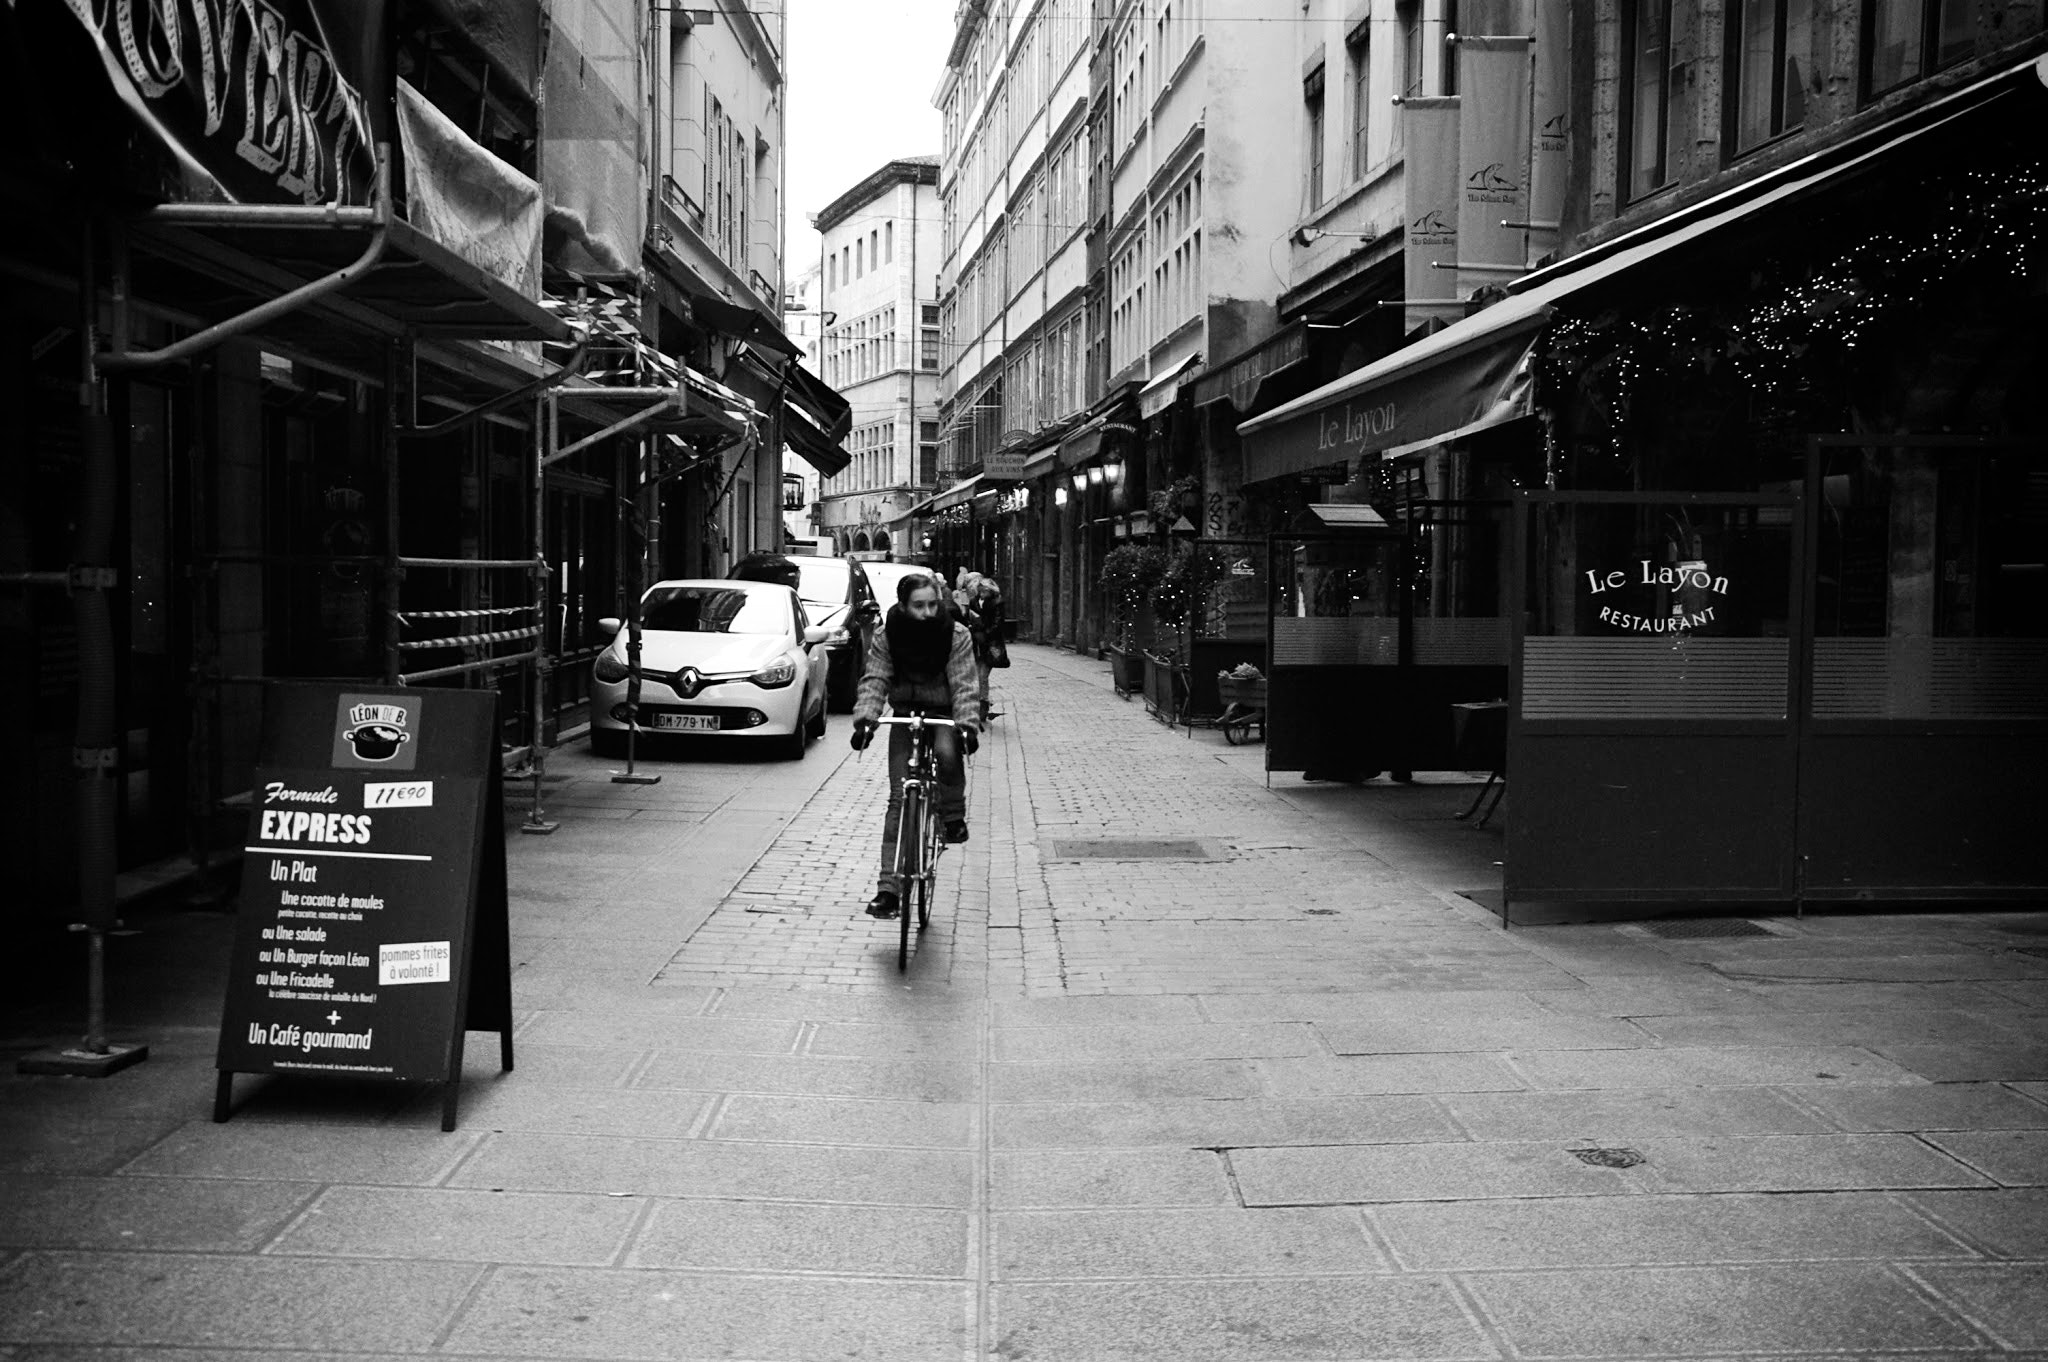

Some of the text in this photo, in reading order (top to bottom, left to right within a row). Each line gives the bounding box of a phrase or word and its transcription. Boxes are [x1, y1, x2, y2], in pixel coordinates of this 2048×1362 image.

[64, 0, 376, 206] UVERT
[1318, 403, 1395, 453] Le Layon
[1585, 560, 1729, 595] Le Layon
[1599, 606, 1716, 633] RESTAURANT
[352, 705, 379, 722] LÉON
[264, 782, 338, 804] Formule
[260, 810, 372, 844] EXPRESS
[270, 860, 317, 882] Un Plat
[281, 890, 384, 909] Une cocotte de moules
[262, 925, 326, 942] ou Une salade
[259, 947, 369, 967] ou Un Burger façon Léon
[382, 946, 449, 965] pommes frites
[256, 971, 334, 988] ou Une Fricadelle
[390, 966, 395, 979] à
[399, 963, 434, 979] volonté
[249, 1023, 372, 1052] Un Café gourmand
